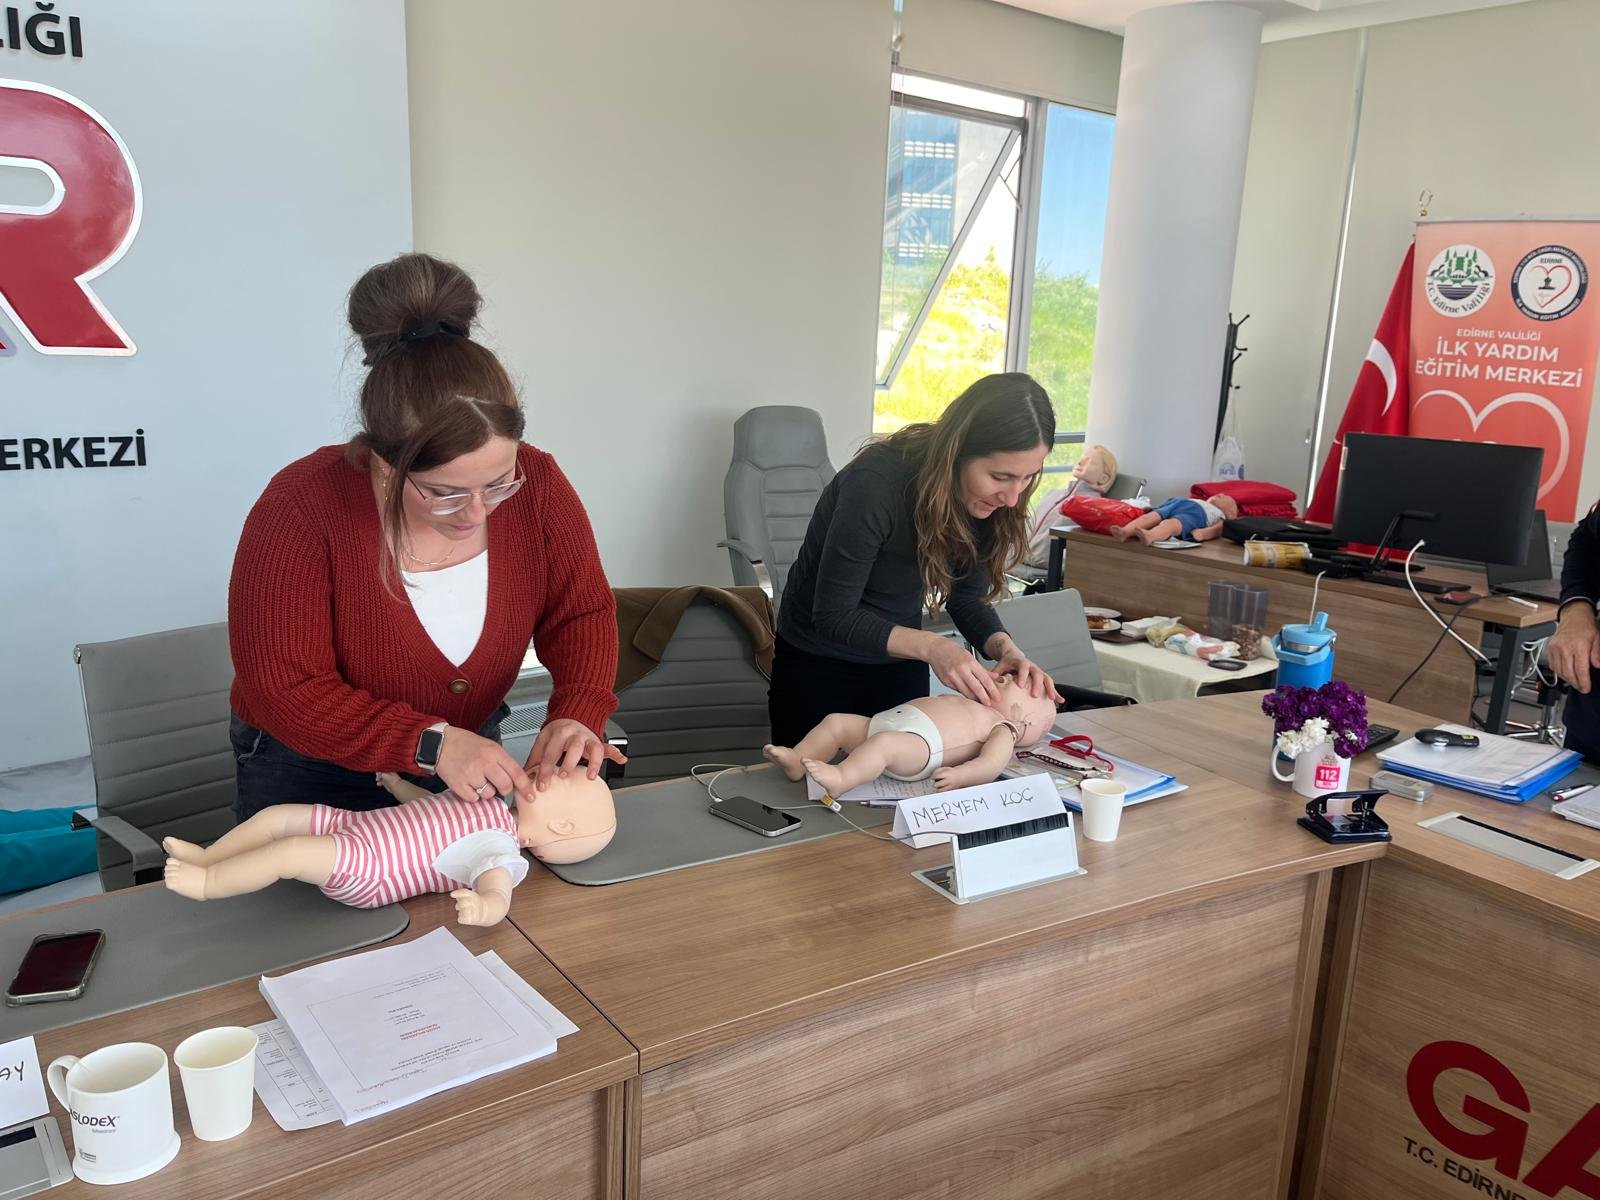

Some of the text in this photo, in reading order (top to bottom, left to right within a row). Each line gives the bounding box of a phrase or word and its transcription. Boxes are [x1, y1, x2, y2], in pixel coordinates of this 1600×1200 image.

[0, 1, 83, 58] IĞI
[1436, 336, 1560, 363] İLK YARDIM
[1456, 327, 1542, 342] EDİRNE VALİLİĞİ
[1415, 357, 1584, 388] EĞİTİM MERKEZİ
[1319, 768, 1337, 781] 112
[912, 797, 990, 828] MERYEM
[1403, 1136, 1438, 1168] T.C.
